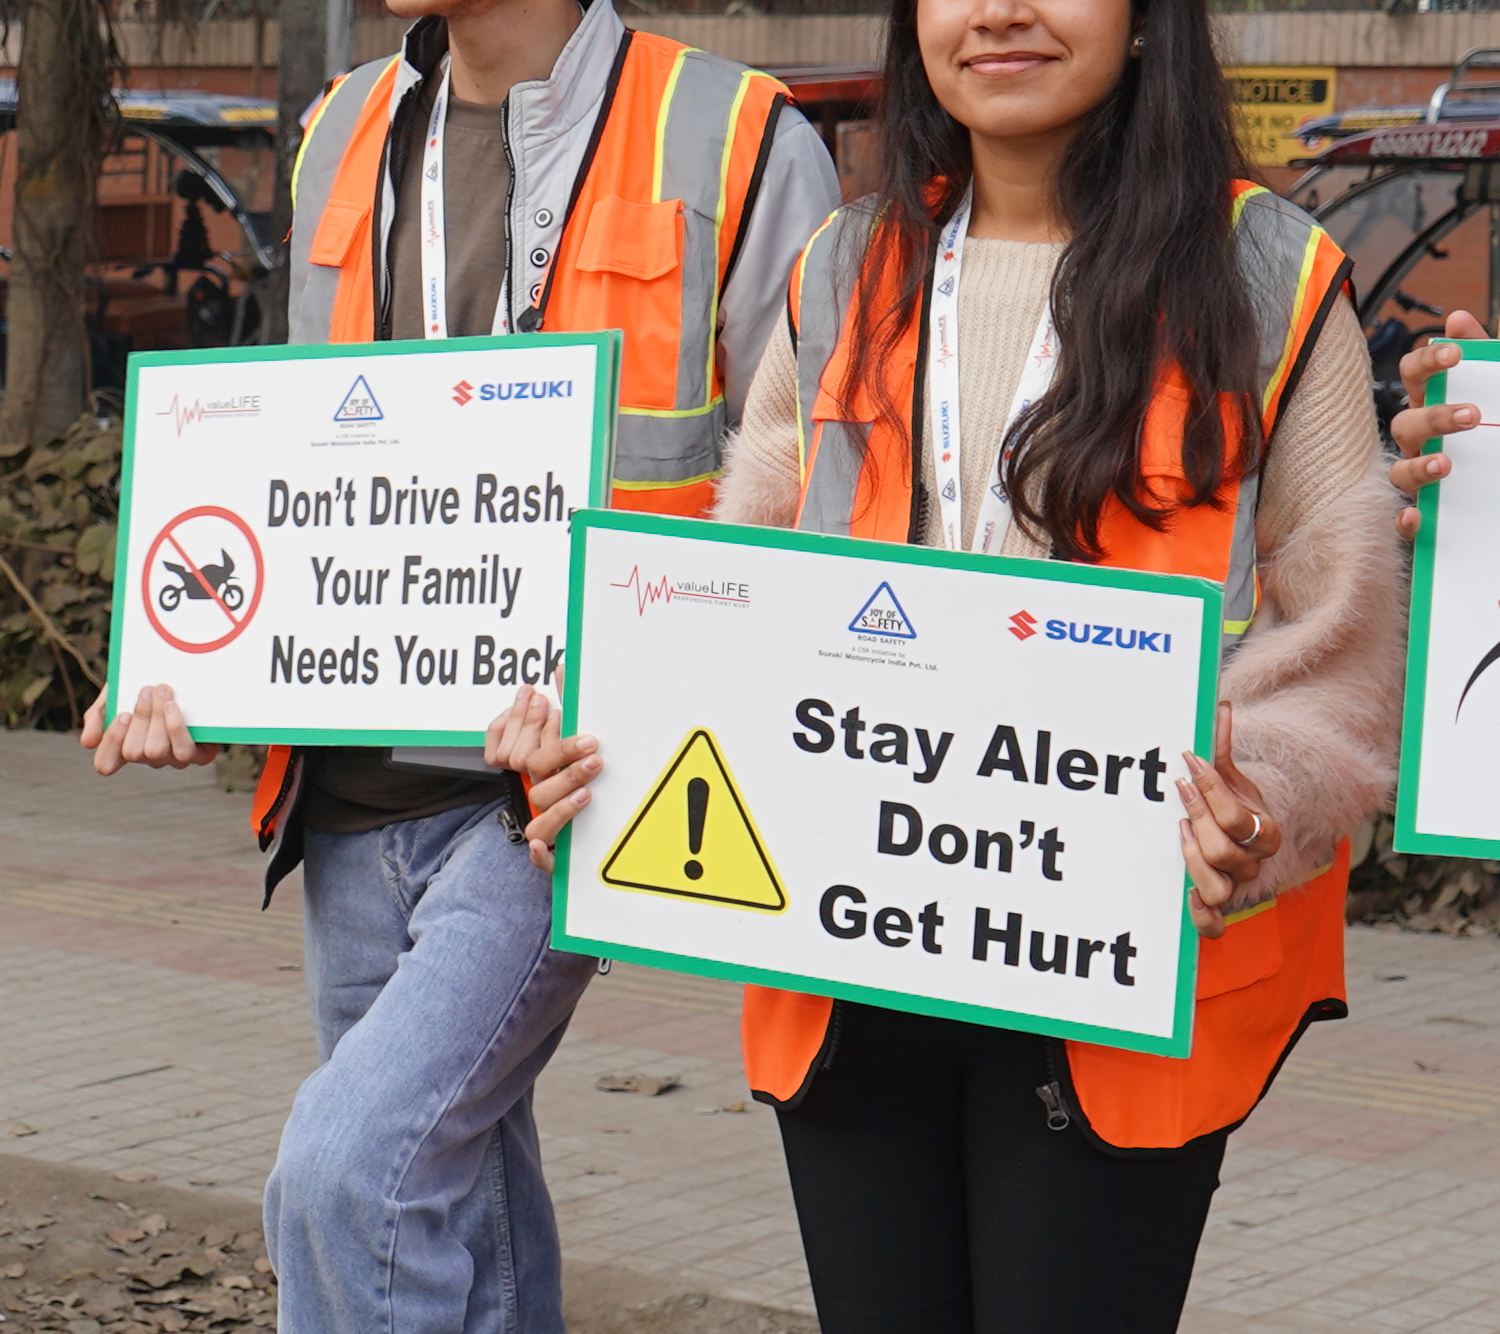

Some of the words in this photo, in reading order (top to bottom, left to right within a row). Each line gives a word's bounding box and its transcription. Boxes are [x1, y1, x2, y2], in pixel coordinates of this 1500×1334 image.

[430, 277, 438, 321] SUZUKI
[479, 380, 573, 400] SUZUKI
[941, 401, 950, 449] SUZUKI
[267, 476, 357, 527] Don't
[369, 475, 459, 526] Drive
[311, 555, 390, 606] Your
[401, 554, 522, 619] Family
[676, 580, 750, 598] valueLIFE
[869, 608, 883, 617] JOY
[886, 610, 896, 619] OF
[1044, 618, 1172, 654] SUZUKI
[269, 635, 380, 686] Needs
[394, 634, 457, 685] You
[472, 634, 565, 686] Back
[857, 634, 877, 643] ROAD
[879, 637, 906, 646] SAFETY
[791, 698, 954, 783] Stay
[976, 724, 1167, 802] Alert
[876, 800, 1065, 882] Don't
[817, 884, 945, 954] Get
[972, 907, 1138, 986] Hurt
